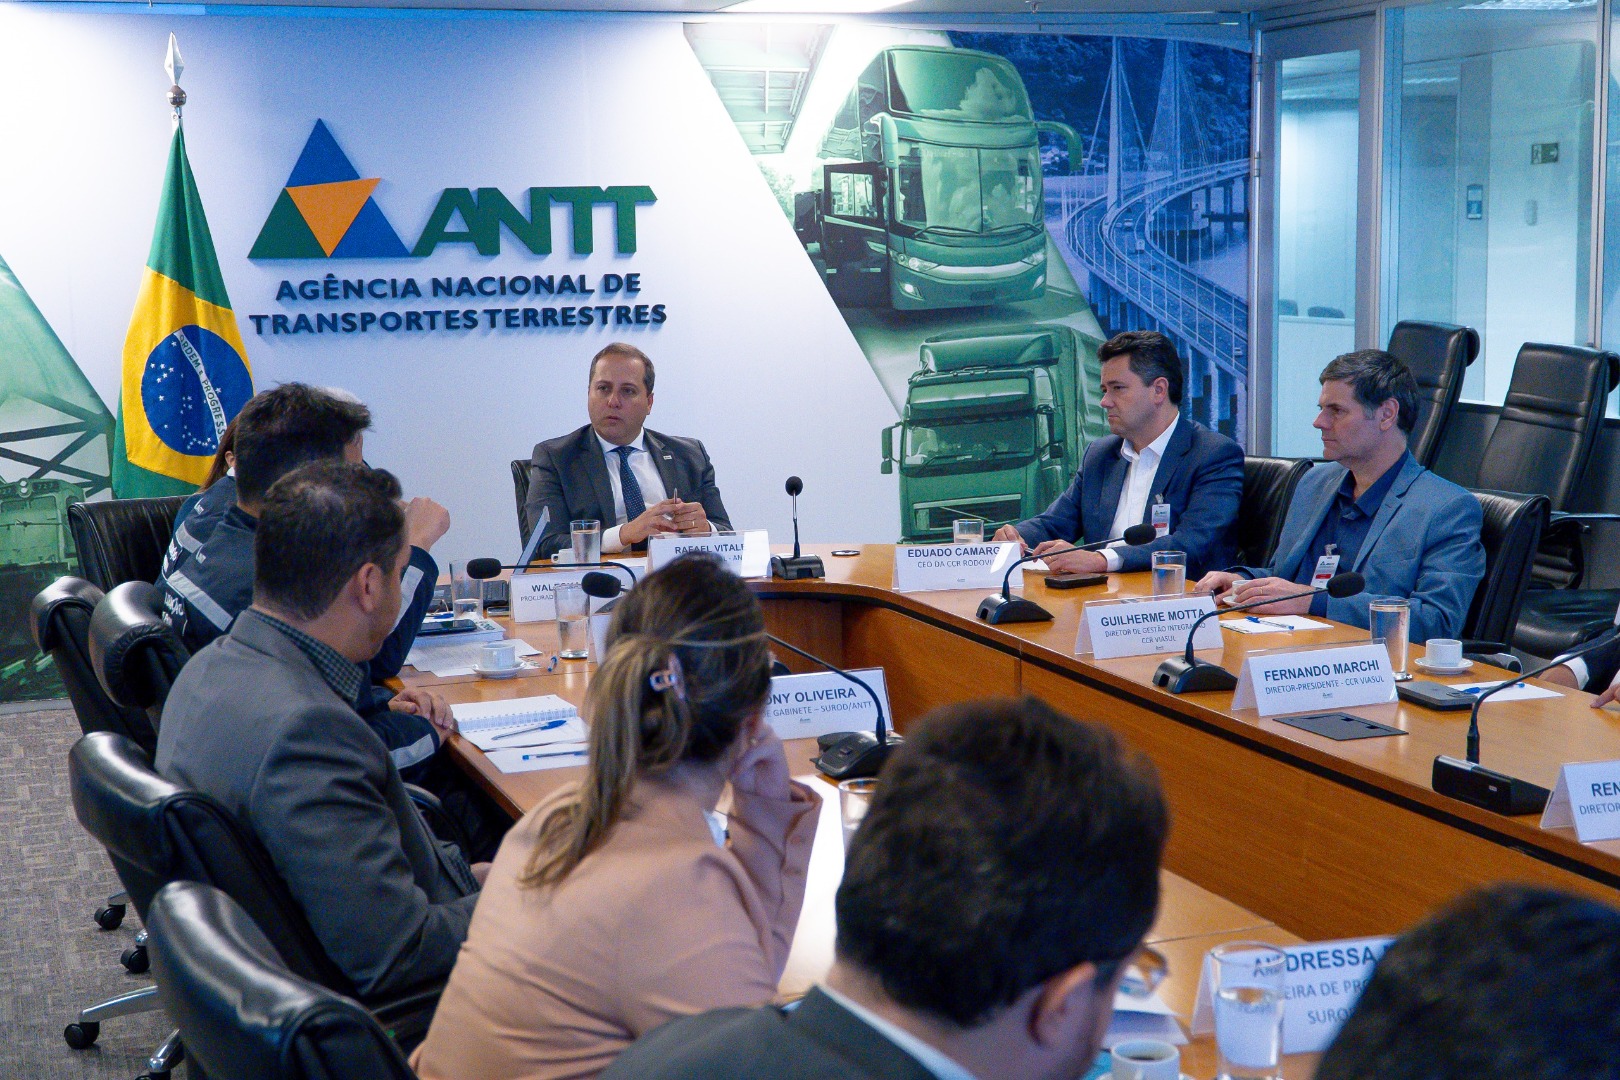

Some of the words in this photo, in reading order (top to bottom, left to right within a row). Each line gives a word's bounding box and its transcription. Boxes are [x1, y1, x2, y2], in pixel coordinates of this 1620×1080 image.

[411, 185, 658, 256] ANTT
[275, 273, 422, 301] AGÊNCIA
[432, 274, 595, 298] NACIONAL
[604, 273, 642, 293] DE
[248, 308, 479, 335] TRANSPORTES
[483, 303, 667, 329] TERRESTRES
[179, 334, 201, 368] ORDEM
[202, 379, 226, 437] PROGRESS
[675, 545, 712, 554] RAFAEL
[907, 548, 952, 558] EDUADO
[955, 546, 1000, 557] CAMARG
[963, 559, 994, 567] RODOVI
[1101, 612, 1166, 627] GUILHERME
[1168, 608, 1206, 621] MOTTA
[1105, 628, 1132, 638] DIRETOR
[1142, 625, 1167, 634] GESTÃO
[1167, 622, 1206, 632] INTEGRAO
[1155, 635, 1177, 643] VIASUL
[1264, 664, 1331, 682] FERNANDO
[1333, 659, 1380, 675] MARCHI
[1265, 680, 1339, 695] DIRETOR-PRESIDENTE
[1345, 677, 1359, 686] CCR
[1360, 675, 1385, 684] VIASUL
[766, 693, 791, 706] ONY
[794, 687, 857, 702] OLIVEIRA
[773, 706, 813, 717] GABINETE
[820, 701, 873, 713] SUROD/ANTT
[1320, 980, 1339, 997] DE
[1307, 1008, 1352, 1025] SURO
